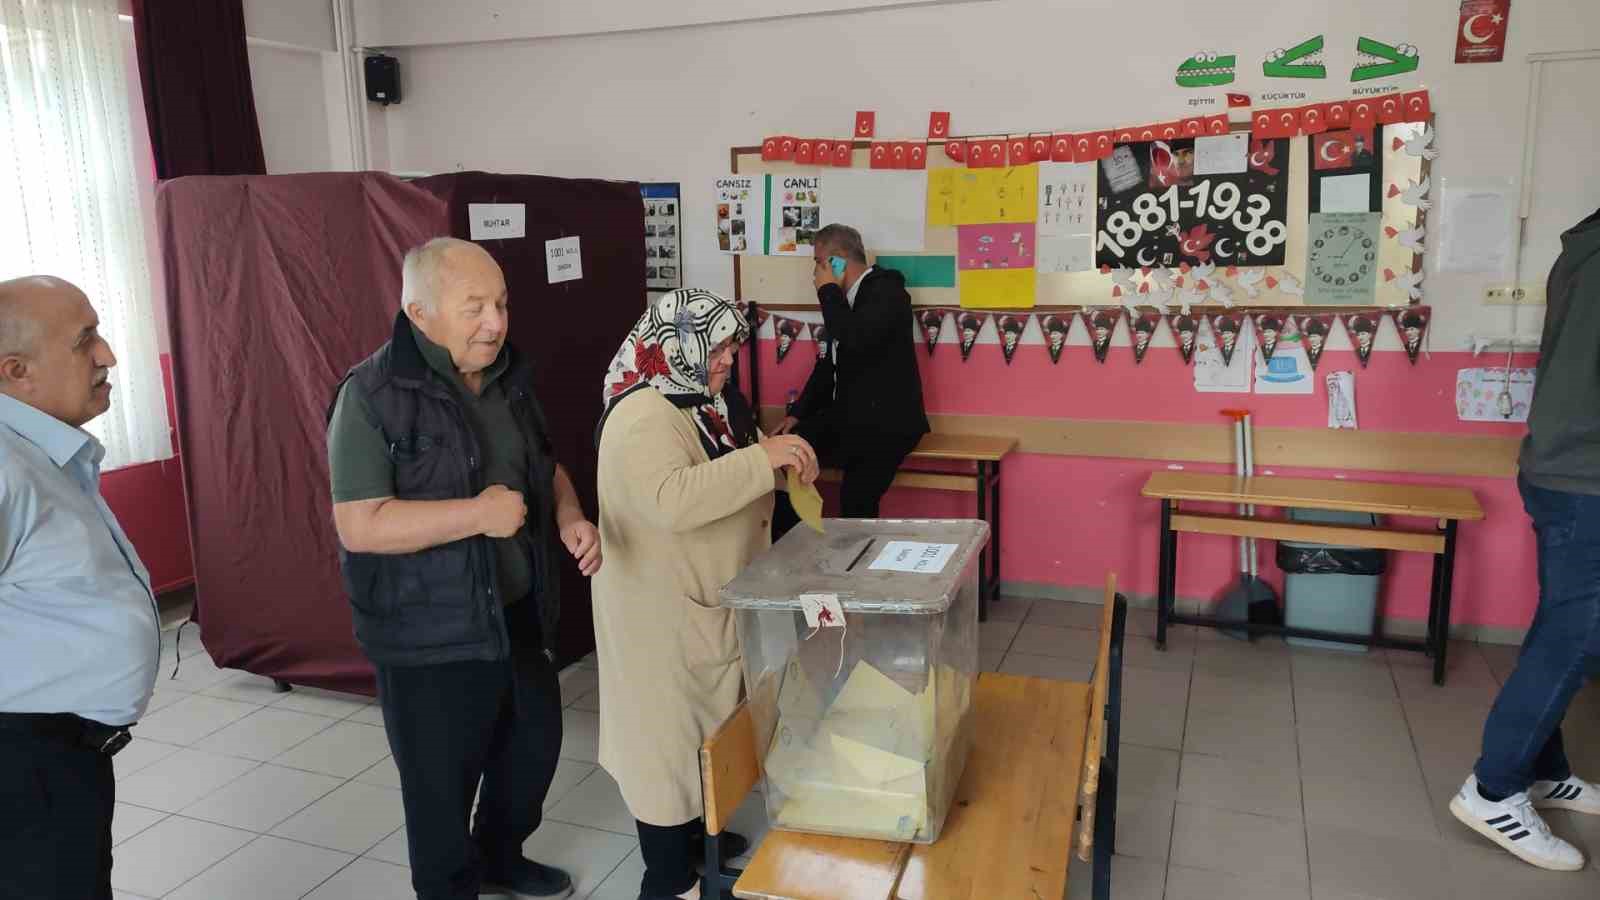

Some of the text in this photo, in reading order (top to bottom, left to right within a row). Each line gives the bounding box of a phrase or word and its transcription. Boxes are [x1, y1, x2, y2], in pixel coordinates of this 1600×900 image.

[716, 179, 751, 188] CANSIZ
[784, 178, 817, 188] CANLI
[1096, 180, 1287, 258] 1881-1938
